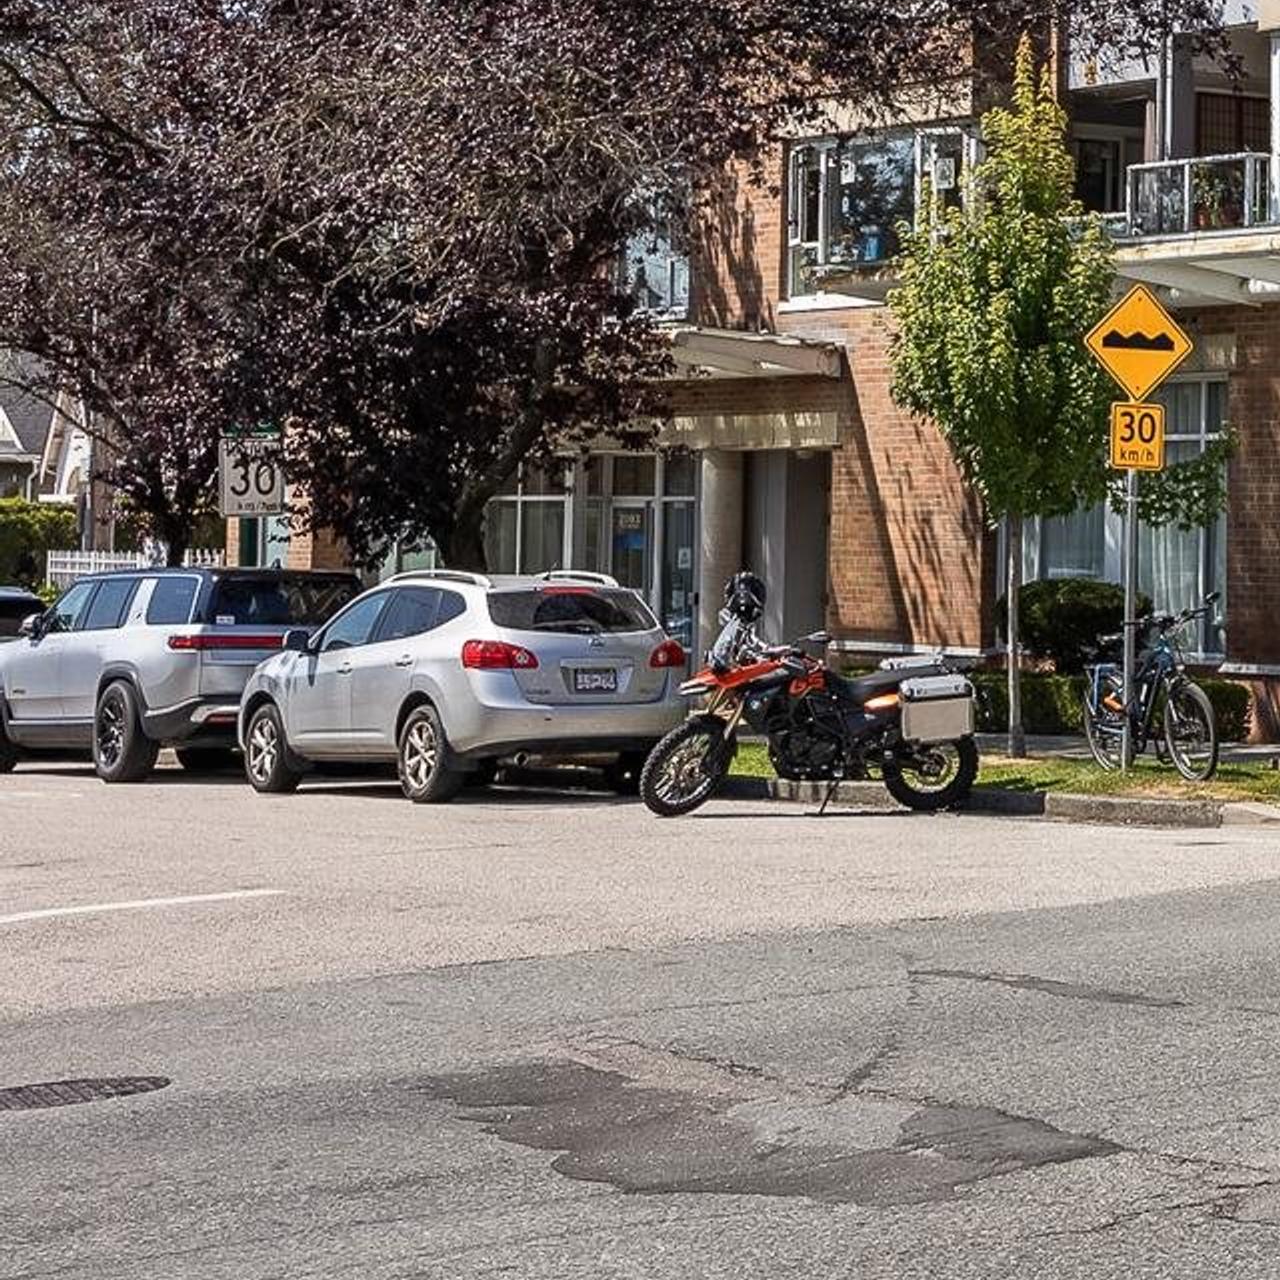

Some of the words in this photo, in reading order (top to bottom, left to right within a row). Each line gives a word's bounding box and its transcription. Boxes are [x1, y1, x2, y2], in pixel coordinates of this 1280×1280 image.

[1120, 411, 1156, 444] 30
[1120, 448, 1155, 463] km/h
[230, 462, 275, 496] 30
